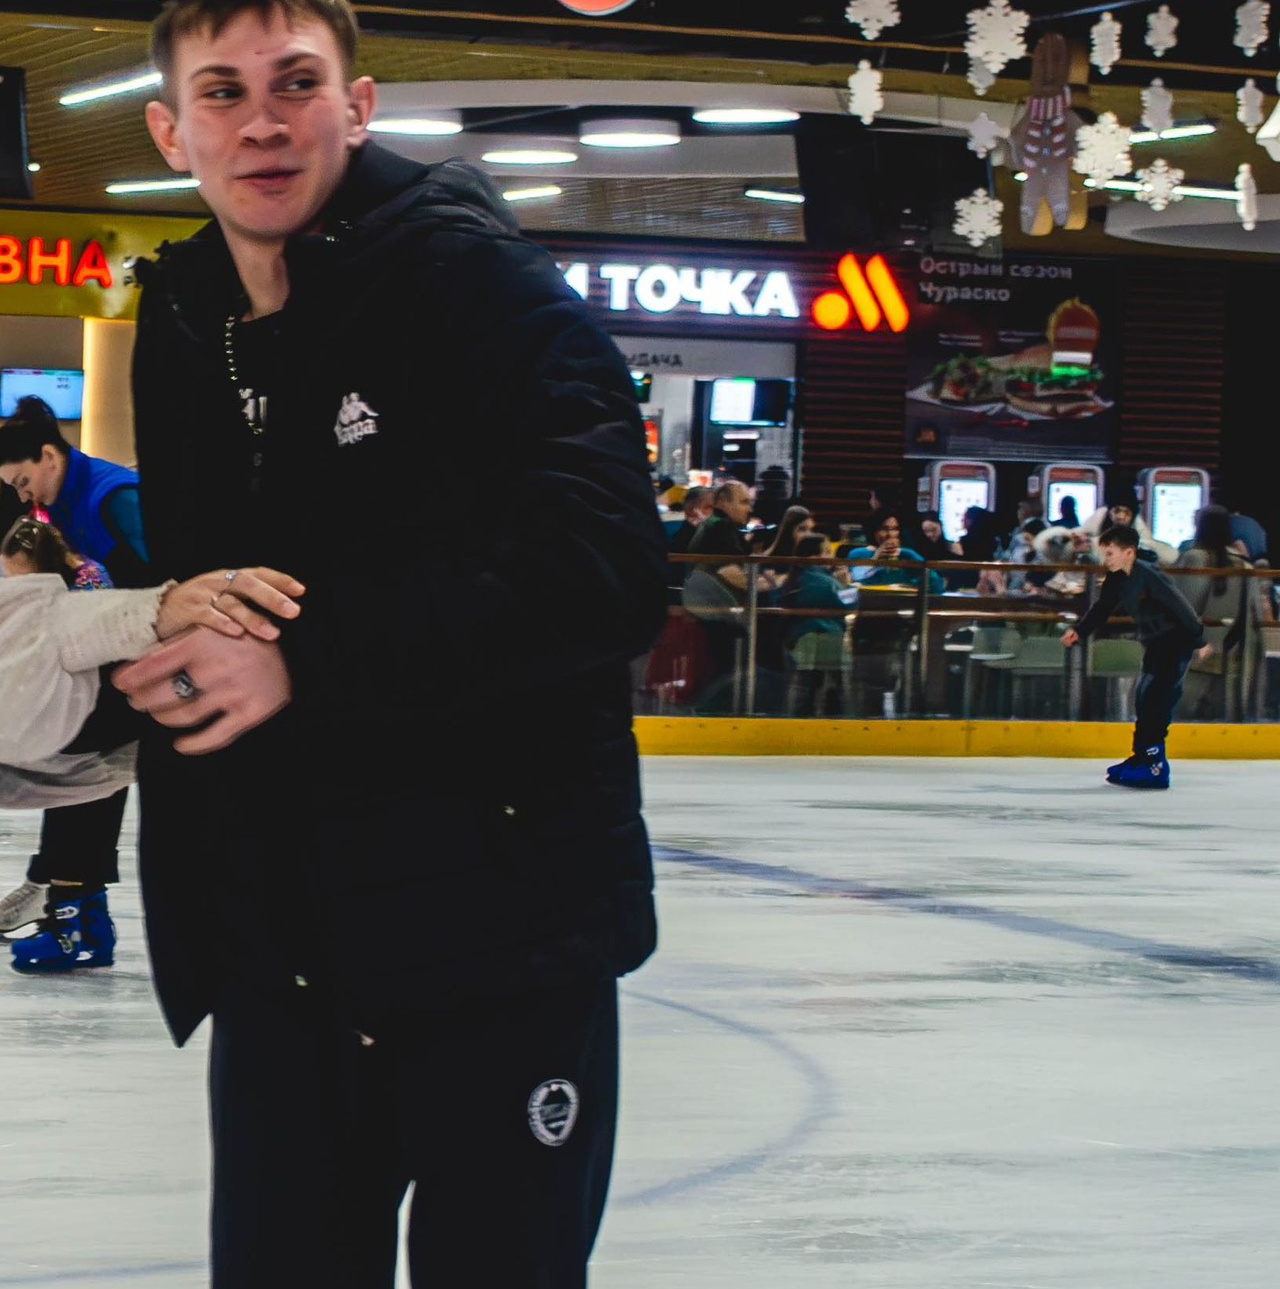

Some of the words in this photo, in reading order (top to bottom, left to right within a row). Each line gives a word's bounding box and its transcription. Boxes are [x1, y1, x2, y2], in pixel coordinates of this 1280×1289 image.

[1009, 264, 1073, 281] сезон
[600, 263, 801, 318] ТОЧКА
[919, 281, 1011, 304] Чураско
